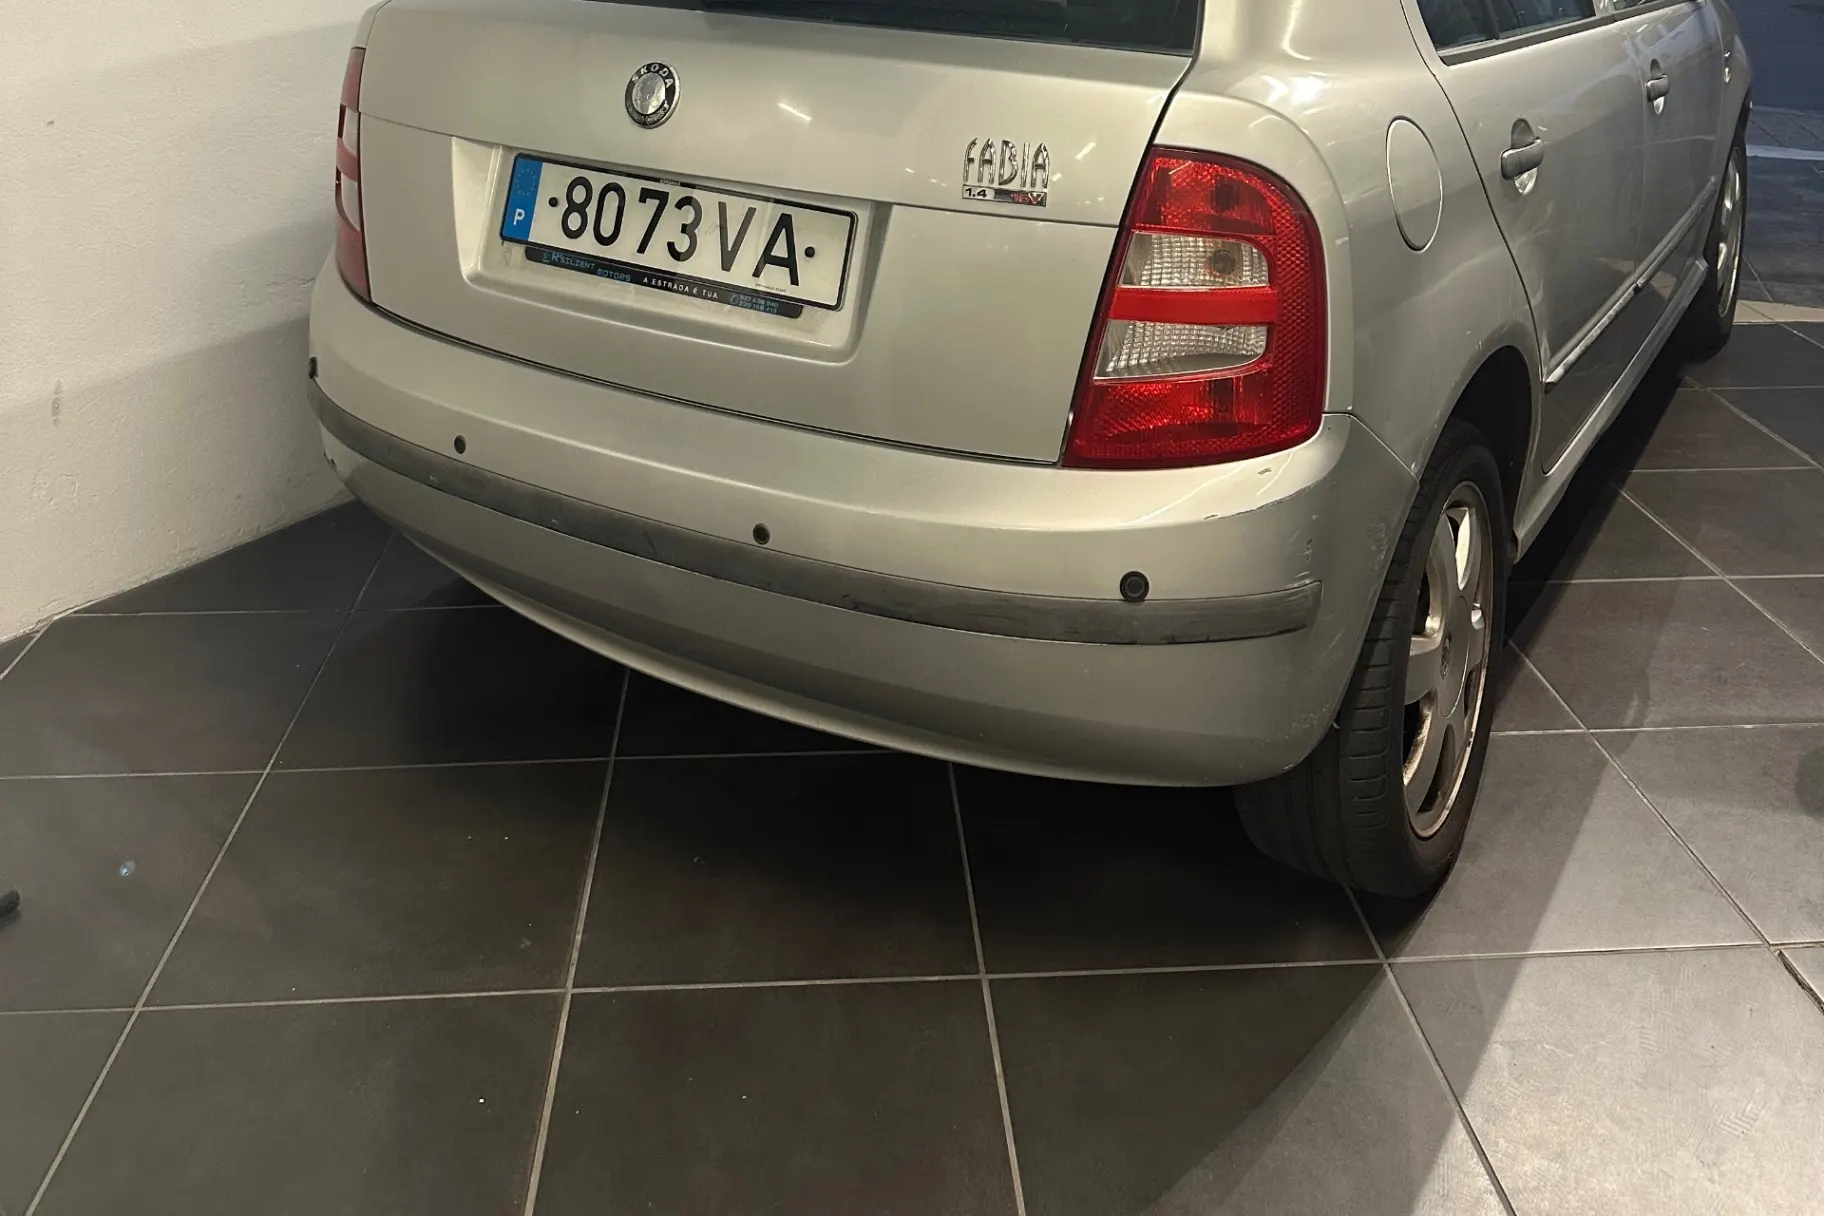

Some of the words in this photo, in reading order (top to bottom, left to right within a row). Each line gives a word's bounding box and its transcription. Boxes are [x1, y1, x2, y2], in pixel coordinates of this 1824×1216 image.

[963, 138, 1050, 188] FABIA
[965, 187, 988, 199] 1.4
[512, 207, 526, 226] P
[651, 278, 689, 293] ESTRADA
[702, 289, 718, 299] TUA
